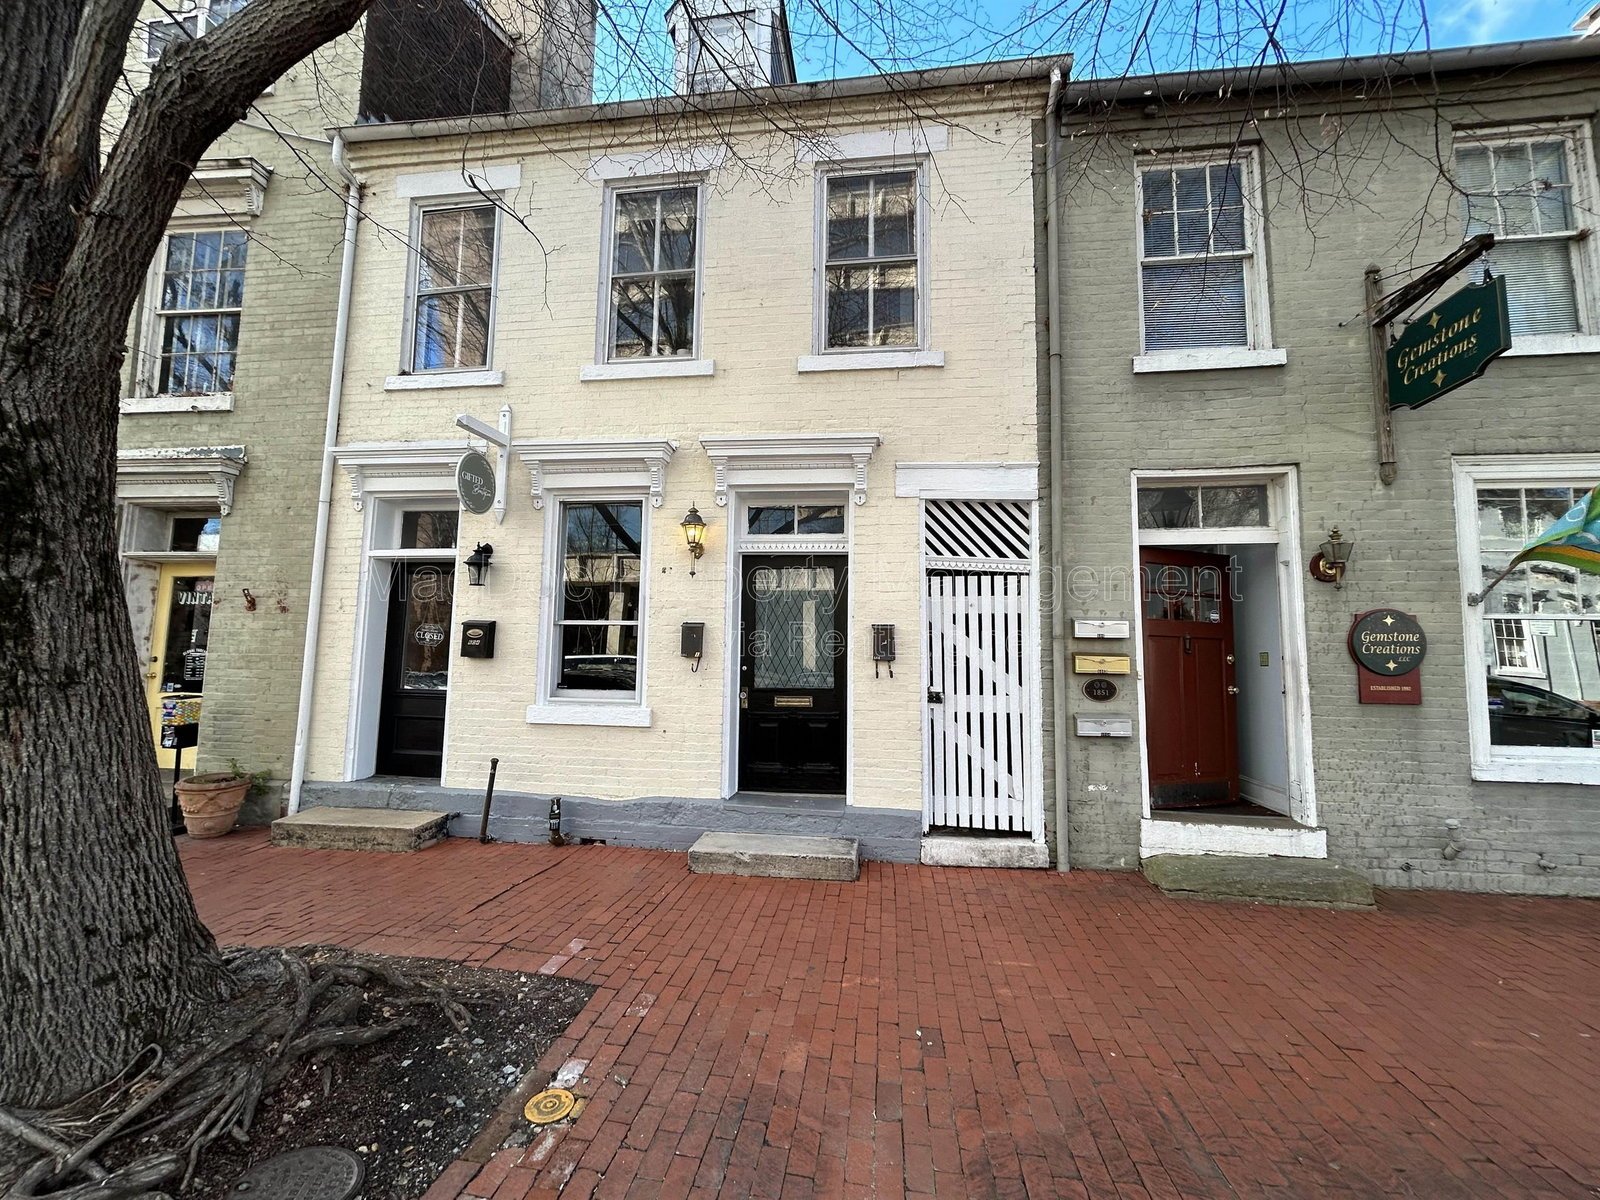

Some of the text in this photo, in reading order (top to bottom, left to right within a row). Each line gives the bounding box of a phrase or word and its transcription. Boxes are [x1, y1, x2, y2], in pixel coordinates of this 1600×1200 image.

[1397, 307, 1481, 374] Gemstone
[1404, 333, 1478, 385] Creations
[461, 470, 483, 486] GIFTED
[415, 630, 444, 641] CLOSED
[1361, 630, 1420, 644] Gemstone
[1362, 643, 1421, 655] Creations
[1093, 688, 1109, 696] 1851
